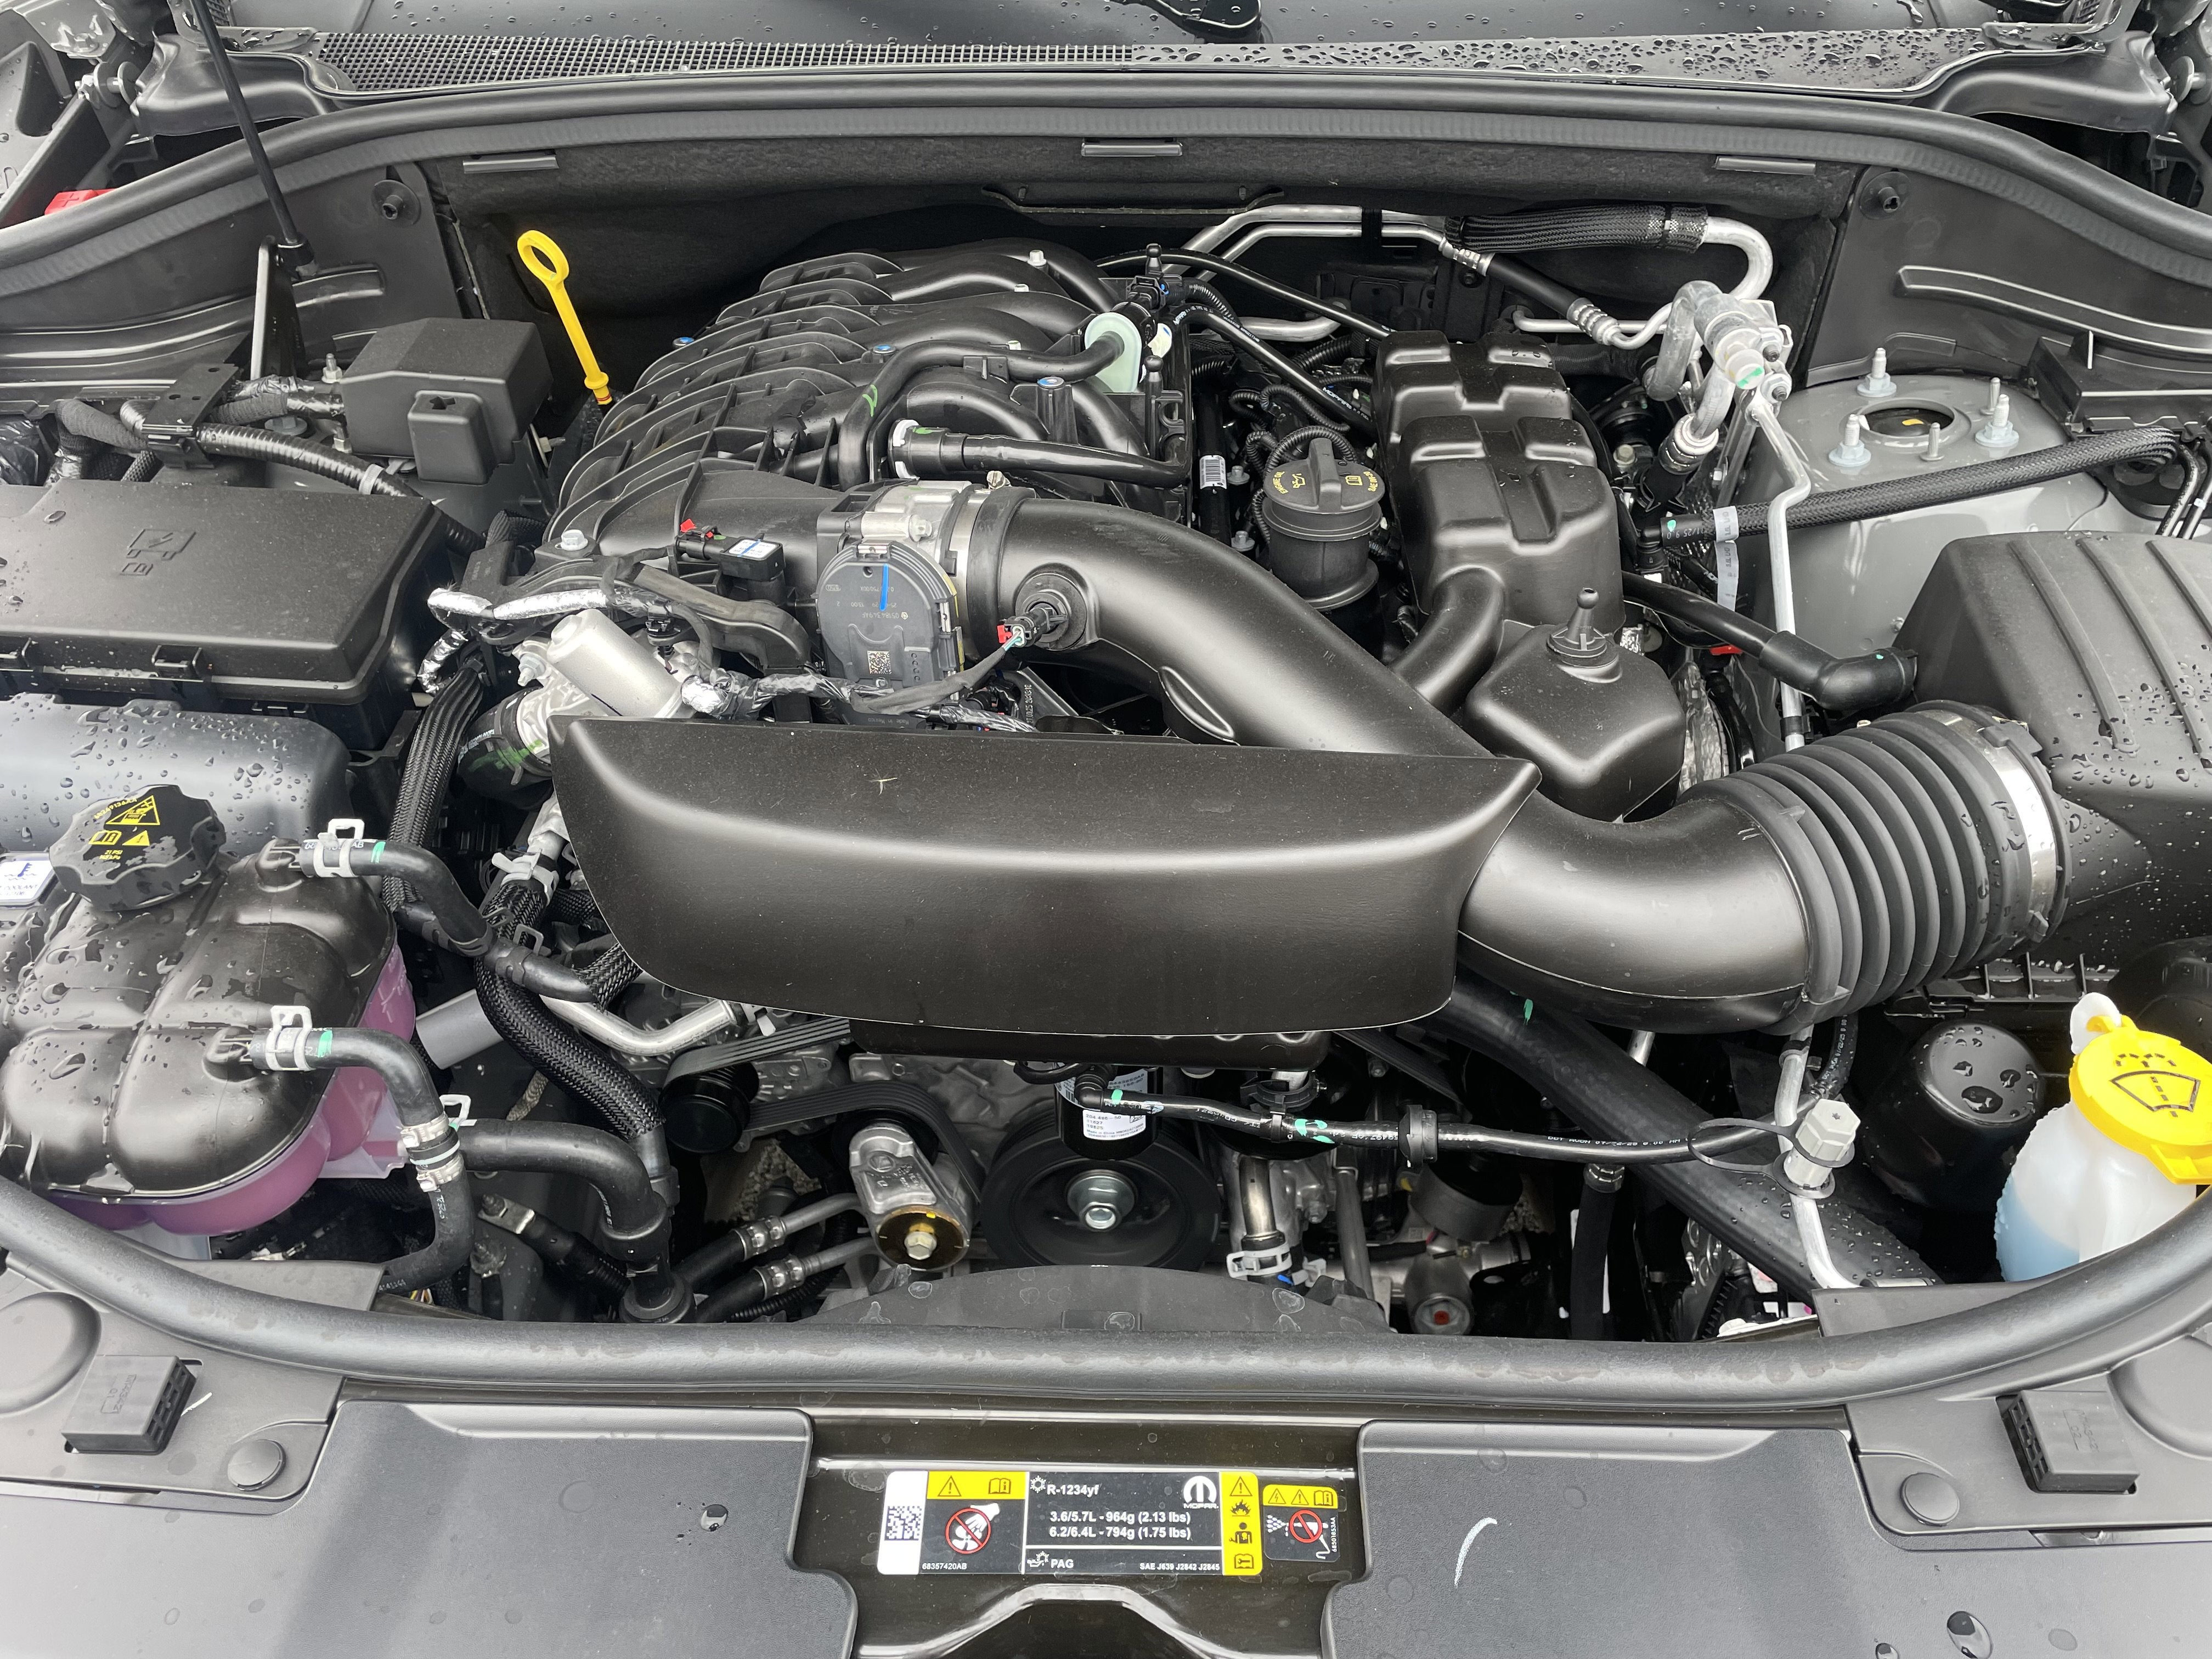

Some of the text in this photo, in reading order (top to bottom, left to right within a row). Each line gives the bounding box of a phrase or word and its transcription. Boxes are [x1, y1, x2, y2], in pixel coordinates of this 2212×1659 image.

[1273, 477, 1289, 494] ENGINE
[1047, 1484, 1100, 1498] R-1234yf
[1049, 1511, 1096, 1522] 3.6/5.7L
[1105, 1511, 1135, 1525] 964g
[1138, 1511, 1166, 1525] (2.13
[1169, 1511, 1191, 1525] lbs)
[1049, 1526, 1096, 1537] 6.2/6.4L
[1105, 1526, 1135, 1540] 794g
[1138, 1526, 1166, 1540] (1.75
[1169, 1526, 1191, 1541] lbs)
[1051, 1559, 1074, 1568] PAG
